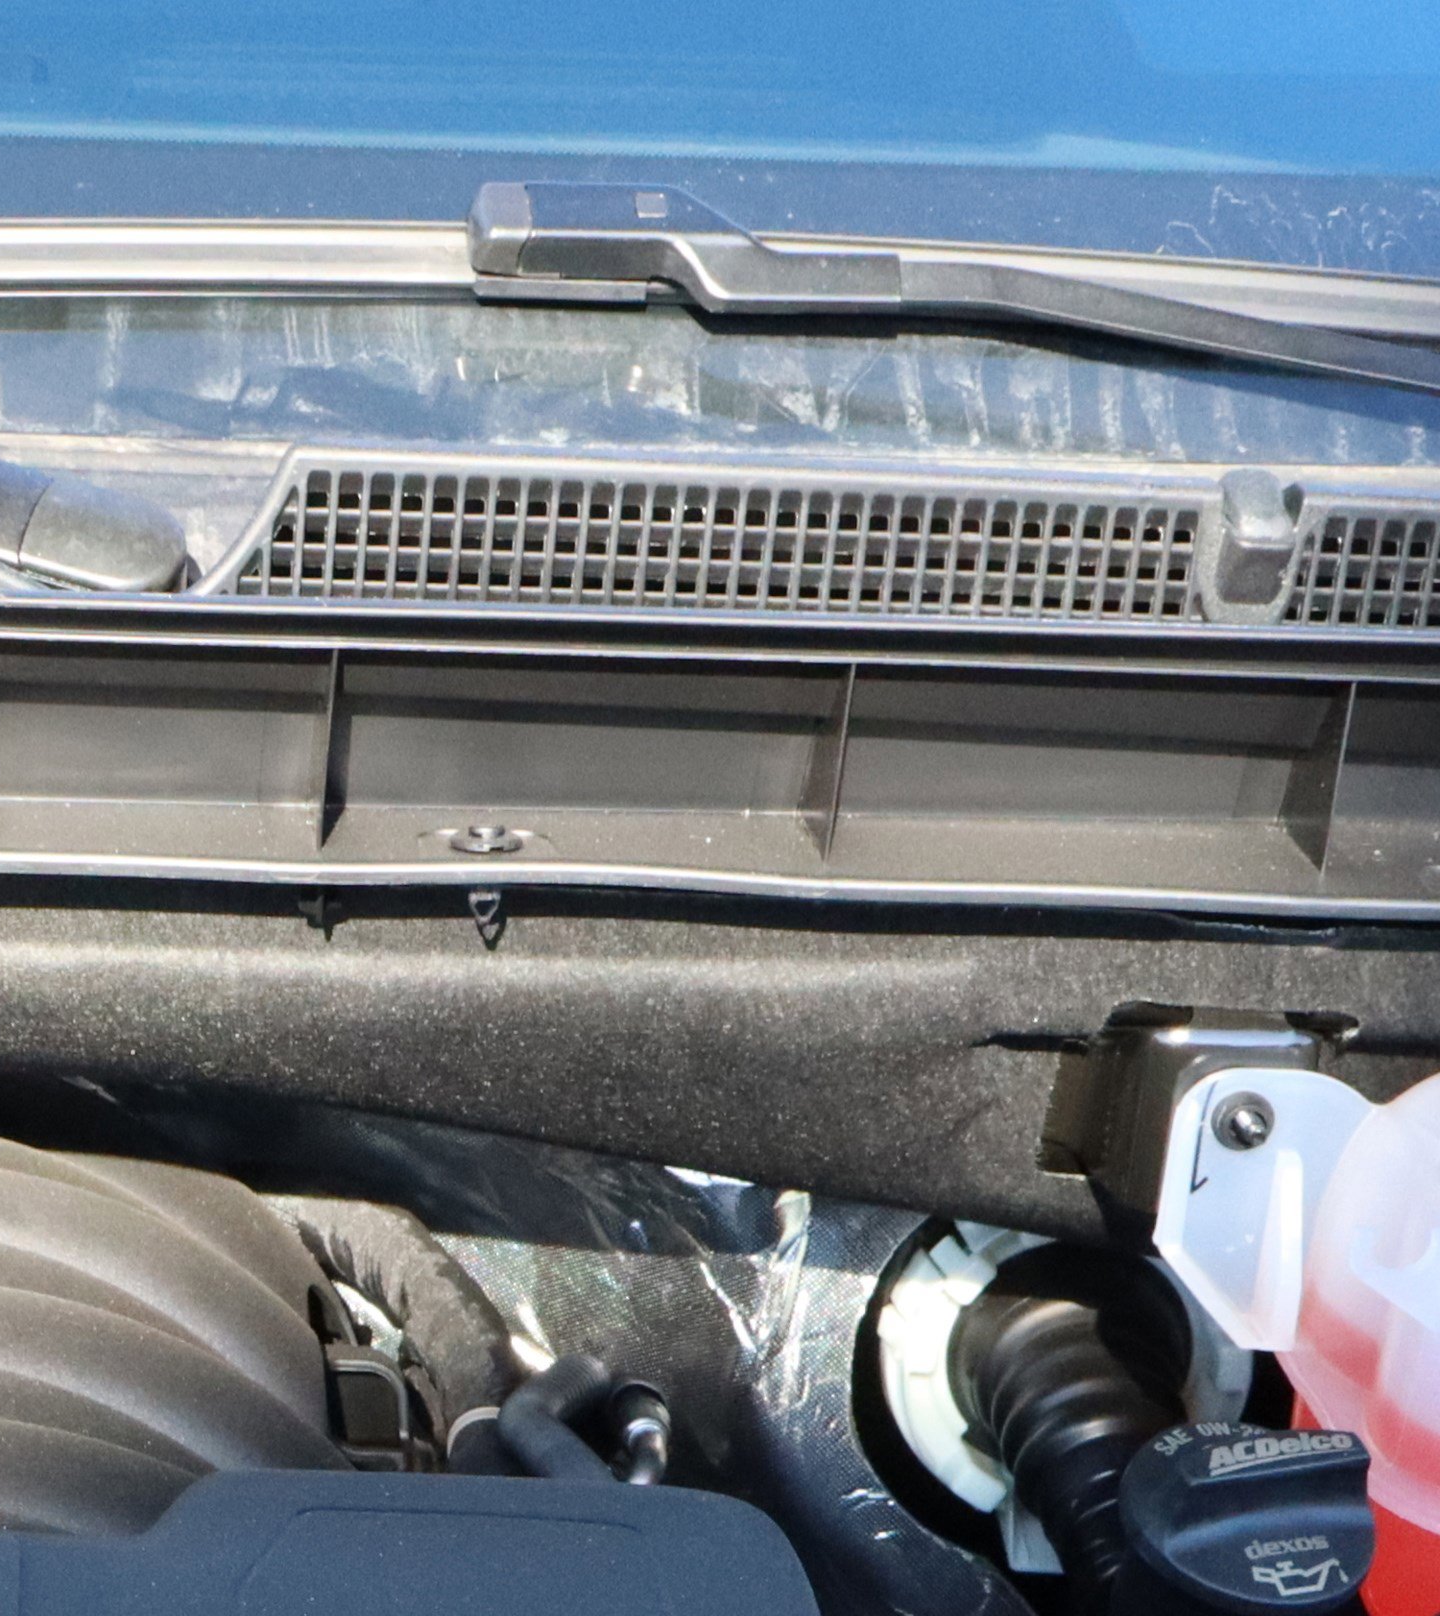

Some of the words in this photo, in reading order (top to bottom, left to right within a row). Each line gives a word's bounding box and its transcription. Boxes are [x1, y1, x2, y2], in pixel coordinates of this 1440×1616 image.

[1154, 1428, 1194, 1456] SAE
[1208, 1432, 1353, 1471] ACDelco
[1244, 1535, 1329, 1560] dexos
